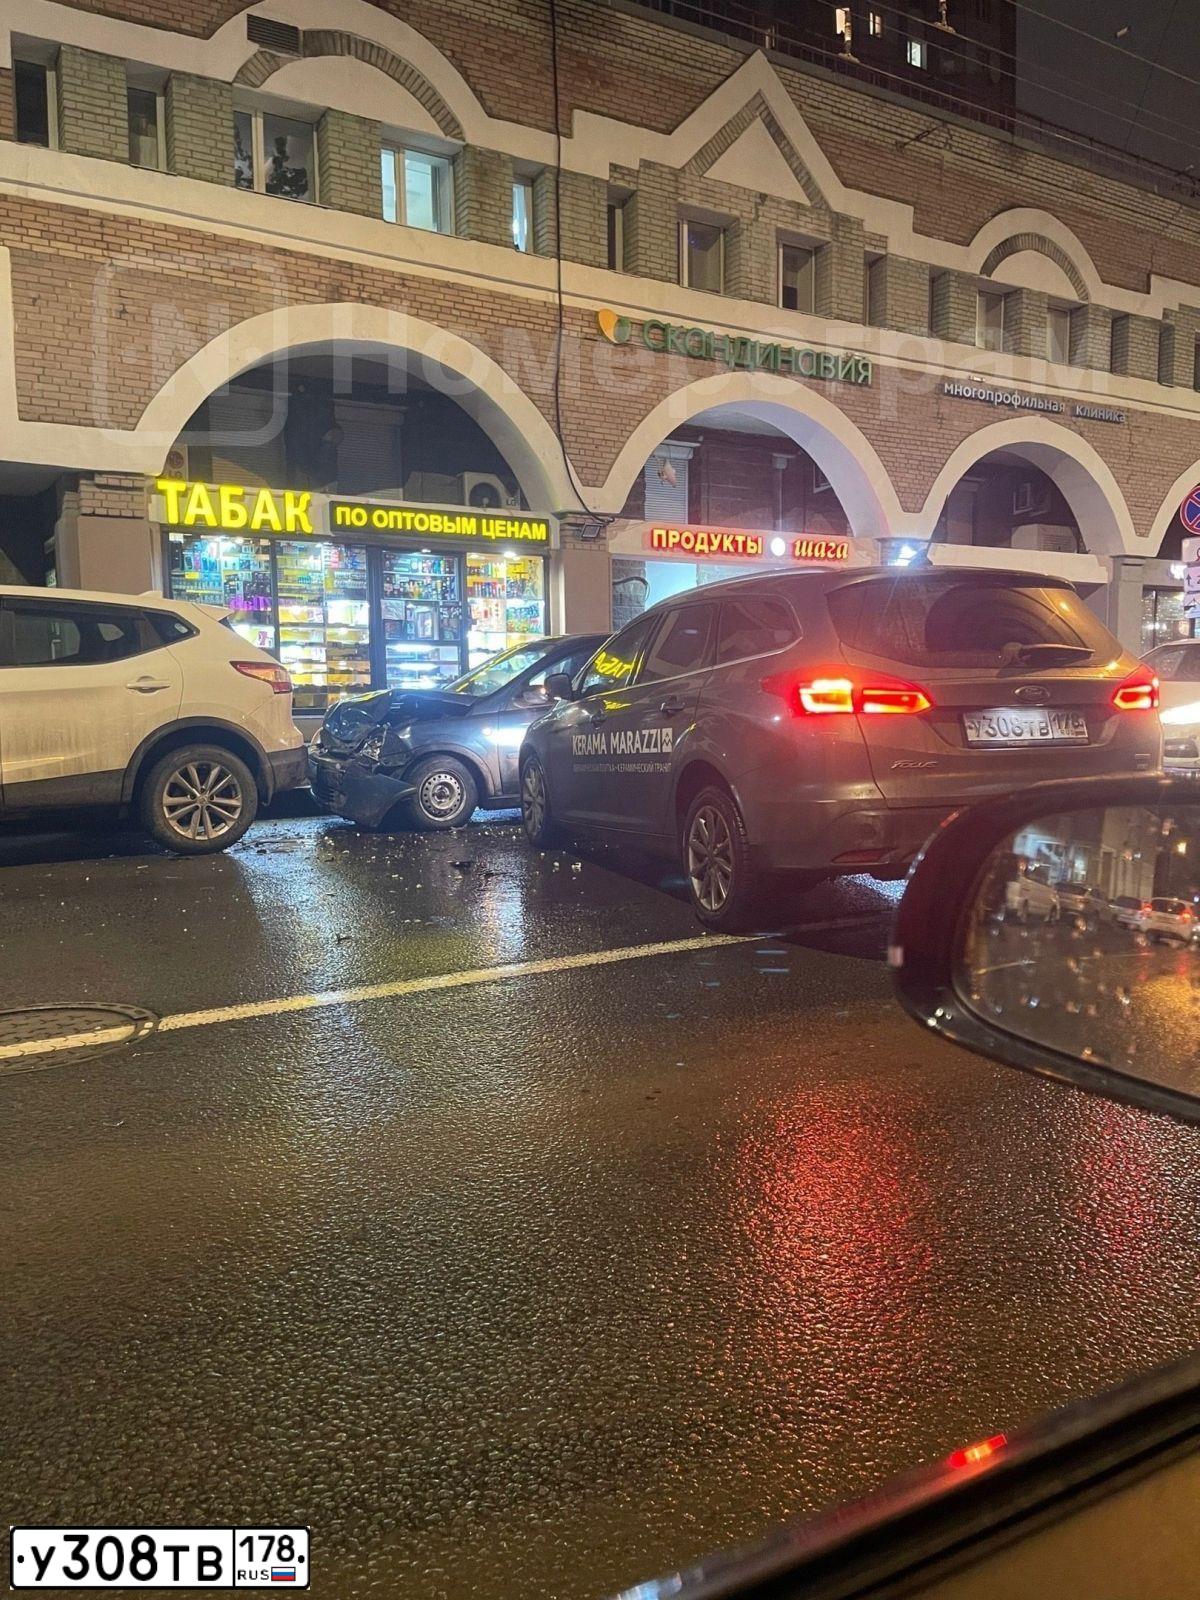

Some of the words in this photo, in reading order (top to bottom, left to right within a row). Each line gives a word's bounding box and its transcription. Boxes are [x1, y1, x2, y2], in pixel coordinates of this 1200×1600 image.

[943, 382, 1066, 413] многопрофильная
[1075, 404, 1127, 423] клиника
[156, 480, 313, 534] ТАБАК
[336, 506, 367, 527] ПО
[372, 509, 477, 535] ОПТОВЫМ
[481, 518, 546, 540] ЦЕНАМ
[652, 528, 763, 554] ПРОДУКТЫ
[1051, 712, 1081, 730] 178
[572, 732, 608, 756] KERAMA
[610, 728, 661, 755] MARAZZI
